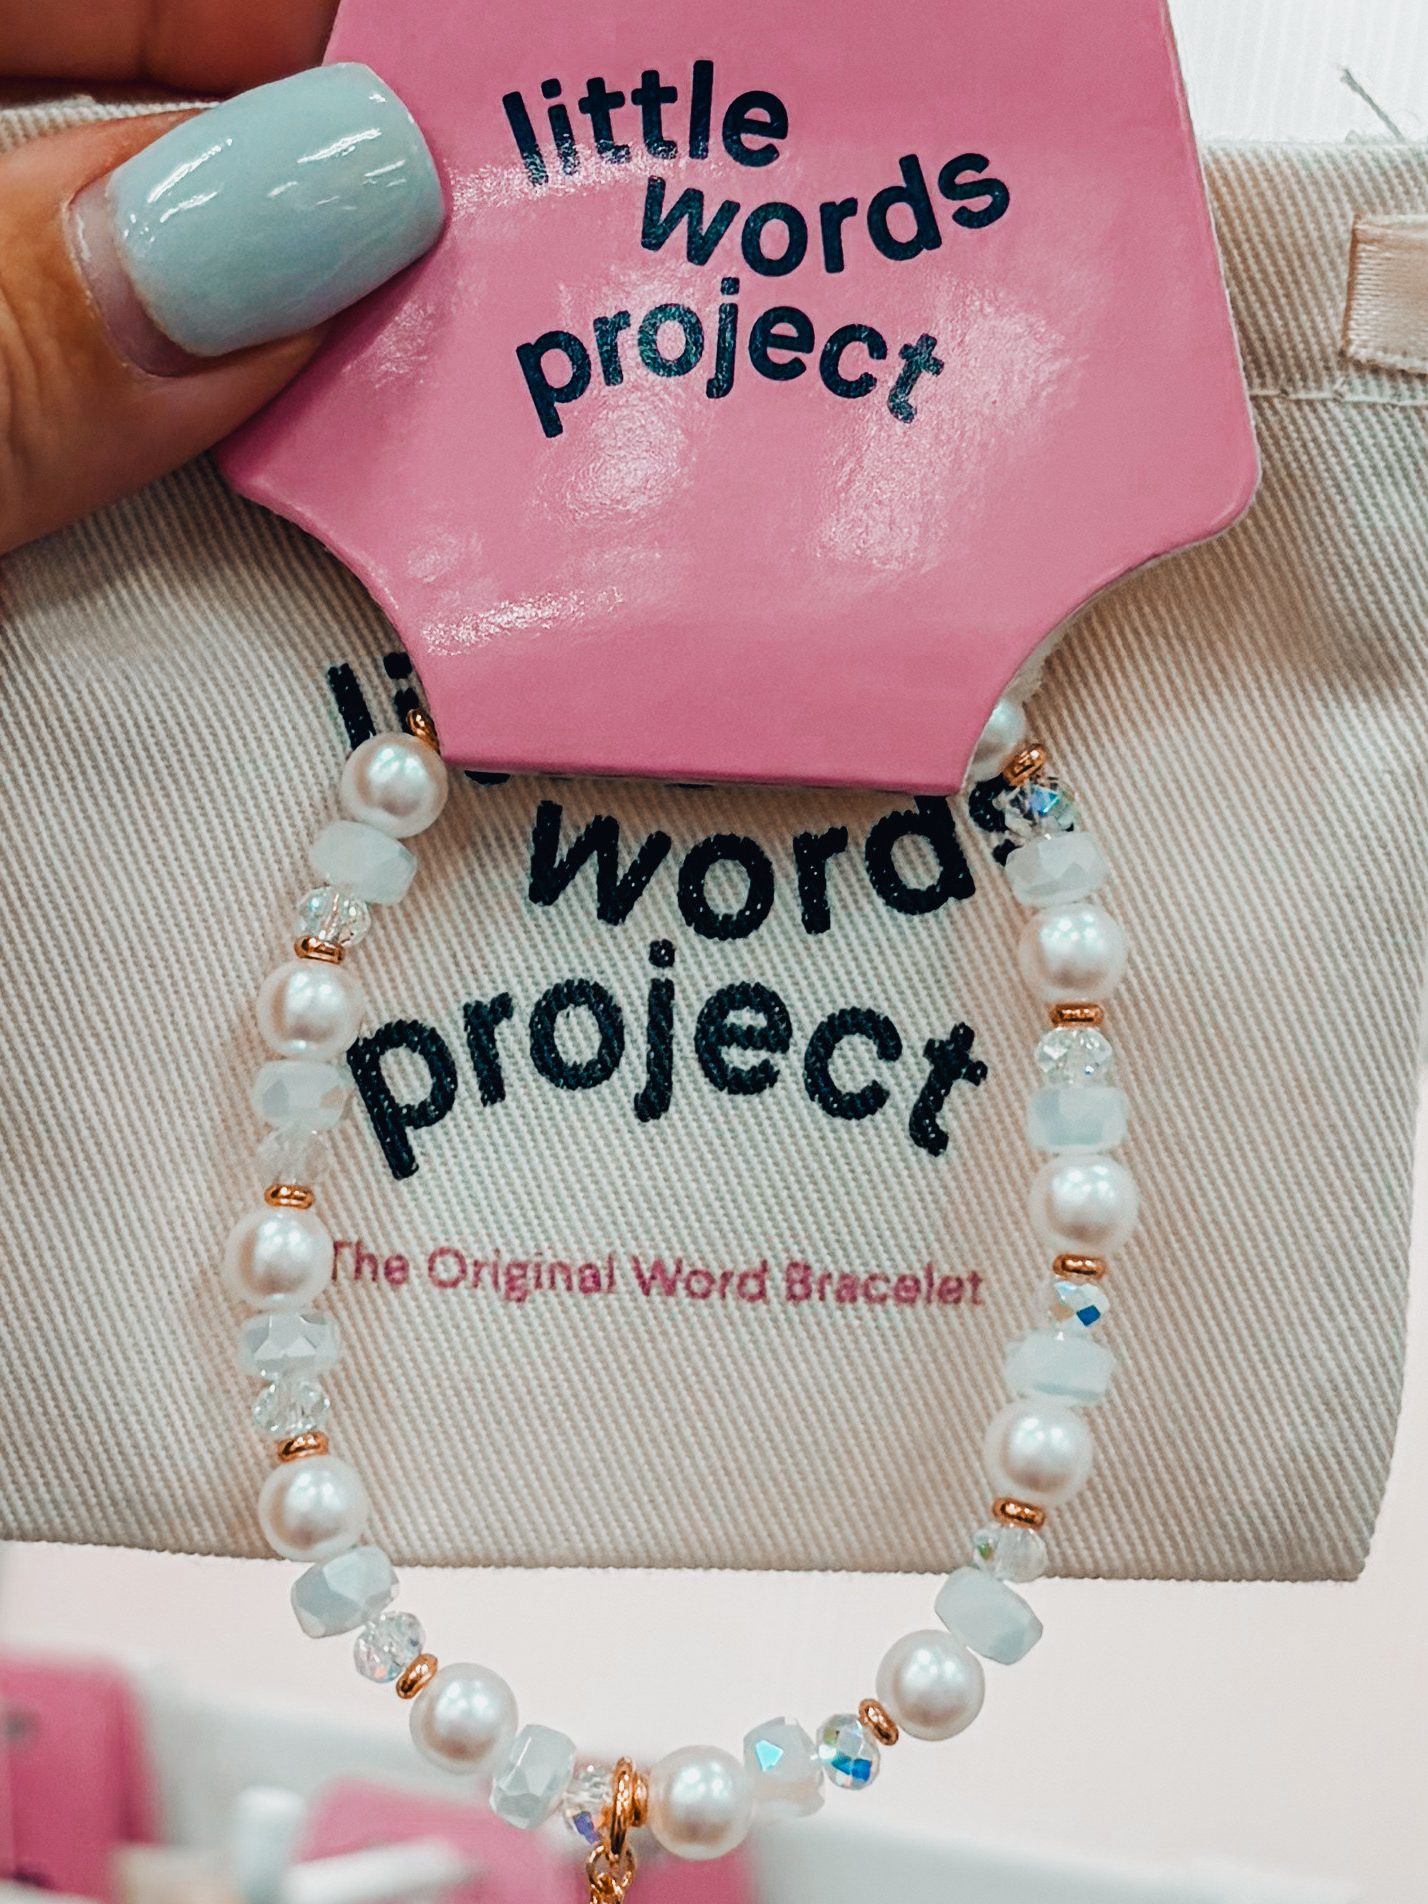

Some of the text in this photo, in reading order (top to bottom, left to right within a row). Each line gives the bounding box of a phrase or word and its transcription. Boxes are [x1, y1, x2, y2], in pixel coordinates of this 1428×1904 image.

[501, 58, 790, 188] little
[639, 151, 1012, 278] words
[514, 276, 946, 439] project
[346, 939, 988, 1181] project
[328, 1238, 984, 1306] The Original Word Bracelet
